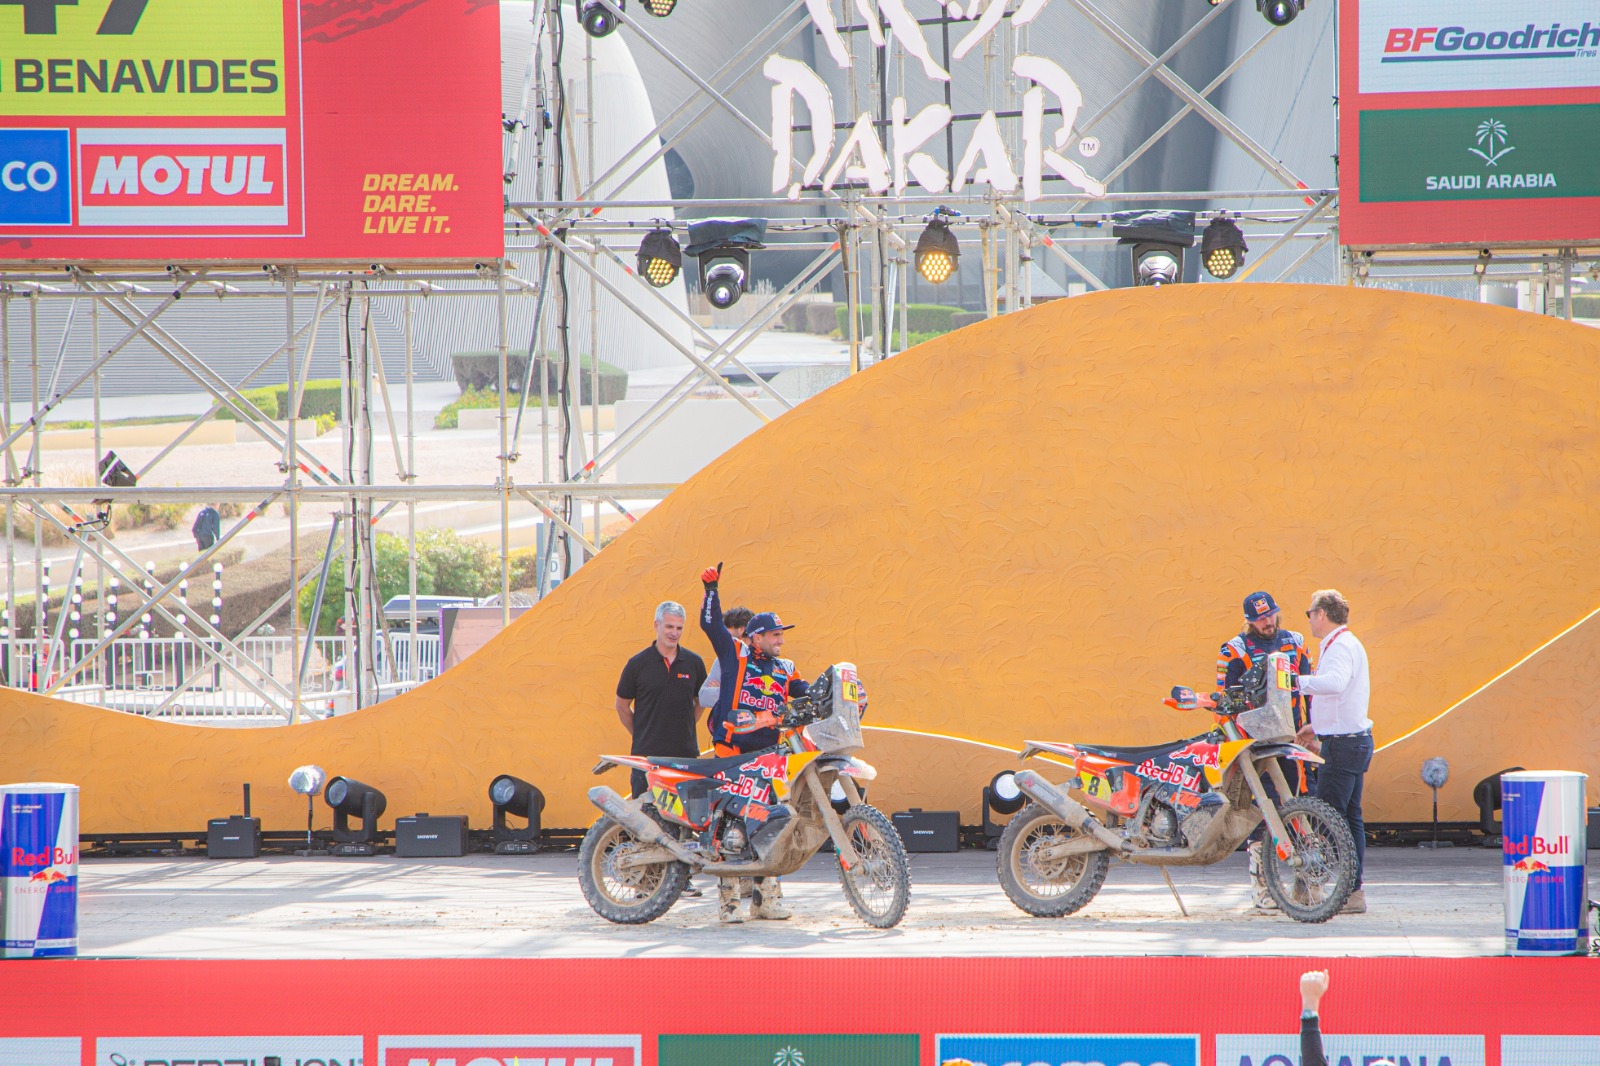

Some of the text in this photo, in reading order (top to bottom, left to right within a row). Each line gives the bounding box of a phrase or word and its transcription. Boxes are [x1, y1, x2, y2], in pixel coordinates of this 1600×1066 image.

[1384, 22, 1600, 53] BFGoodrich
[1576, 49, 1597, 58] Tires
[15, 59, 279, 94] BENAVIDES
[763, 53, 1106, 201] DAKAR
[1081, 143, 1096, 152] TM
[90, 155, 274, 195] MOTUL
[363, 173, 460, 192] DREAM.
[1426, 173, 1557, 190] SAUDI ARABIA
[363, 195, 437, 213] DARE.
[363, 216, 452, 234] LIVE IT.
[740, 689, 766, 709] Red
[1136, 758, 1202, 793] Red Bul
[740, 776, 771, 805] Bul
[1088, 776, 1100, 796] 8
[656, 788, 678, 812] 47
[1532, 836, 1568, 854] Bull
[12, 846, 50, 866] Red
